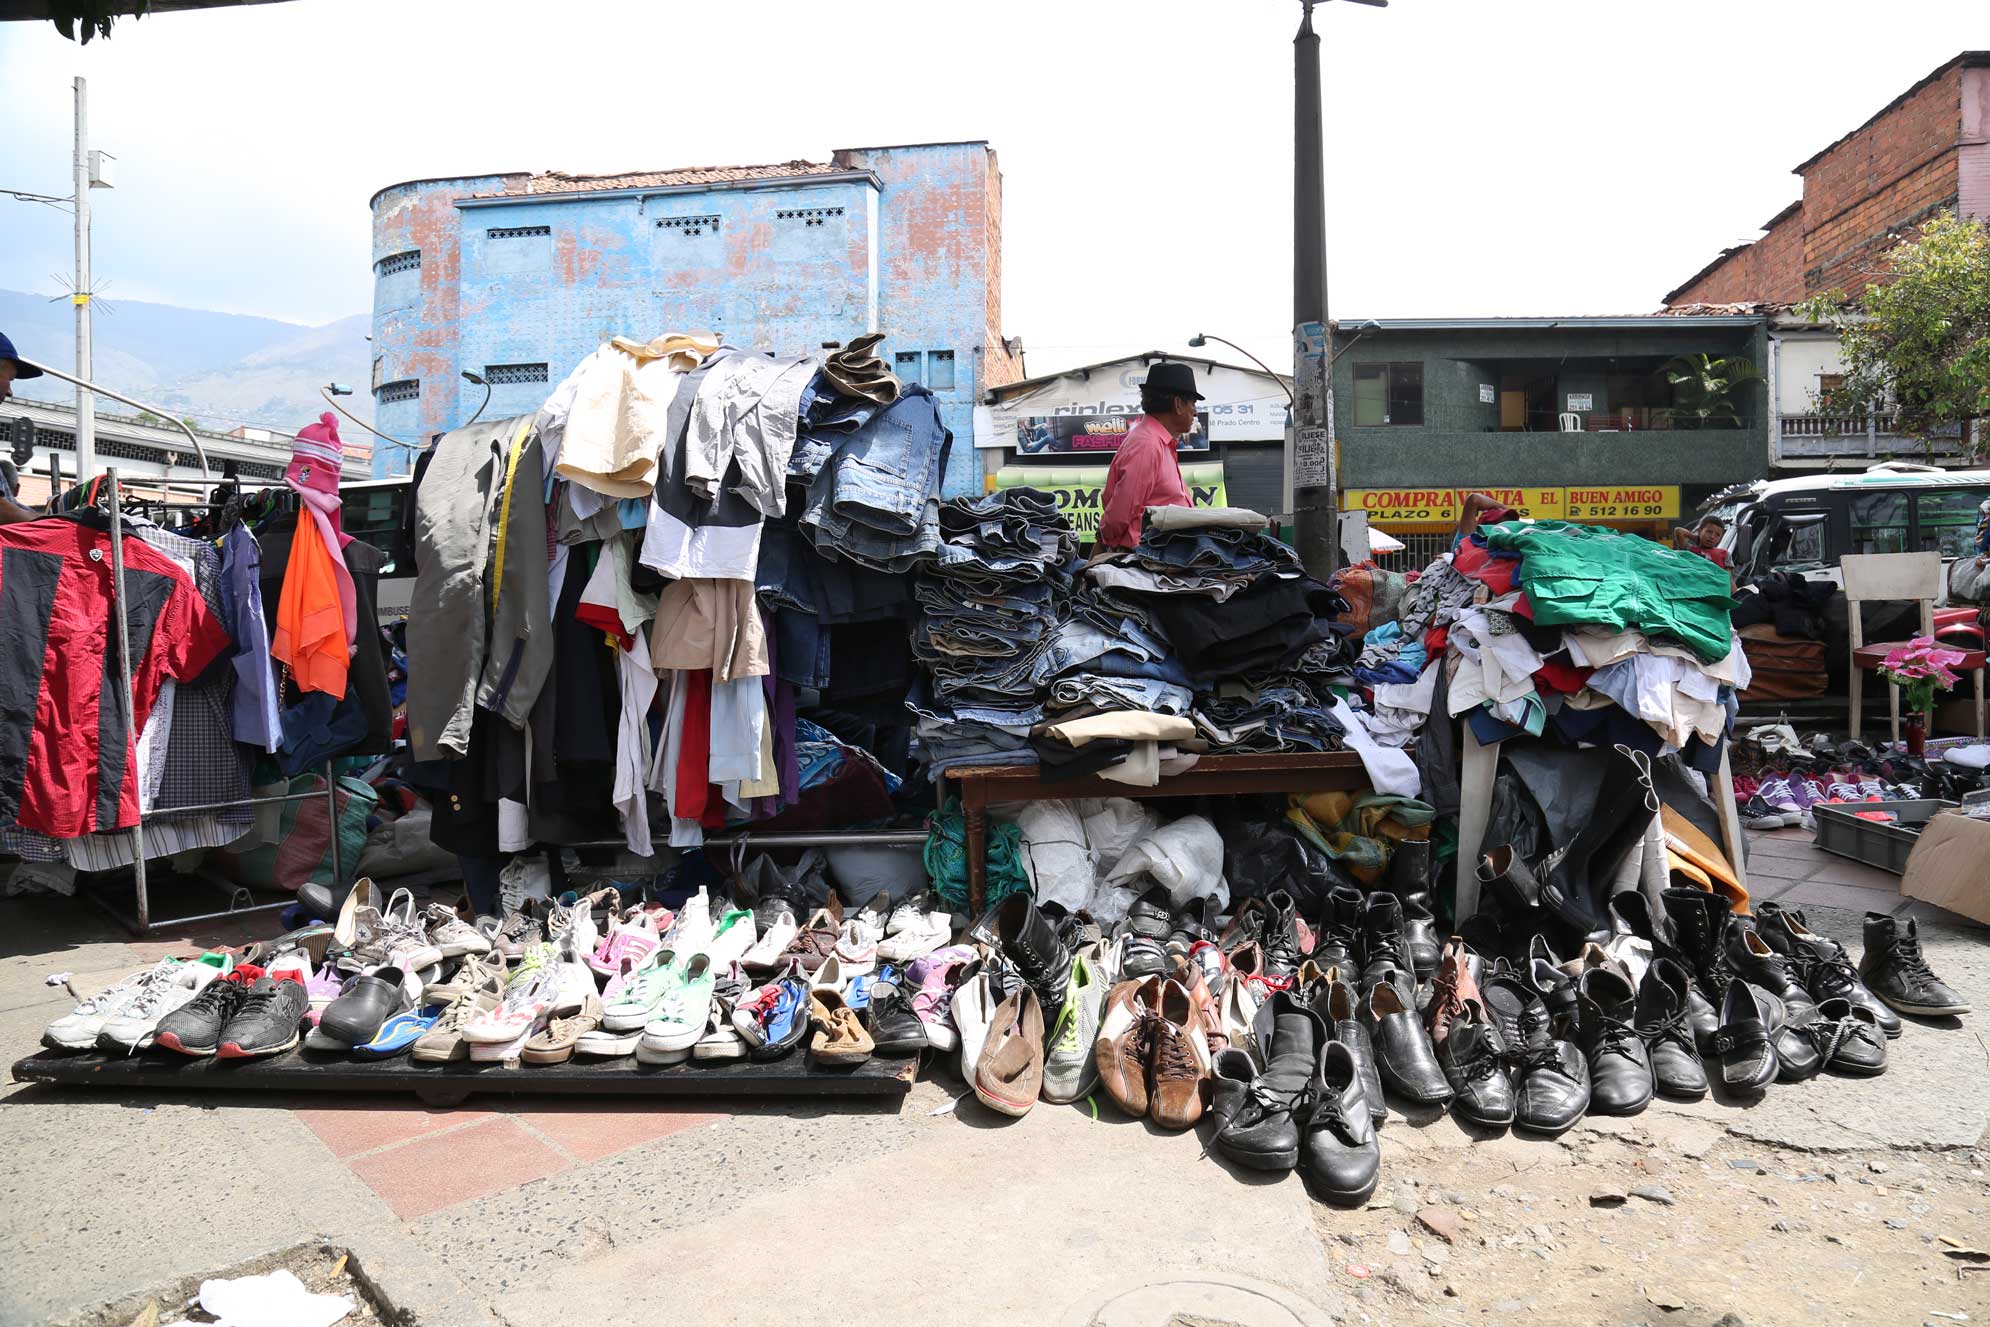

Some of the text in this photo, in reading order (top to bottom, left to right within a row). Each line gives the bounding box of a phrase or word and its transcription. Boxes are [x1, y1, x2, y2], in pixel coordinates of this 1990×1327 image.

[1213, 404, 1233, 414] 05
[1238, 404, 1254, 414] 31
[1541, 492, 1558, 504] EL
[1570, 491, 1610, 504] BUEN
[1613, 490, 1663, 503] AMIGO
[1367, 510, 1451, 519] PLAZO 6
[1589, 505, 1662, 516] 512 16 90
[1063, 511, 1101, 532] EANS
